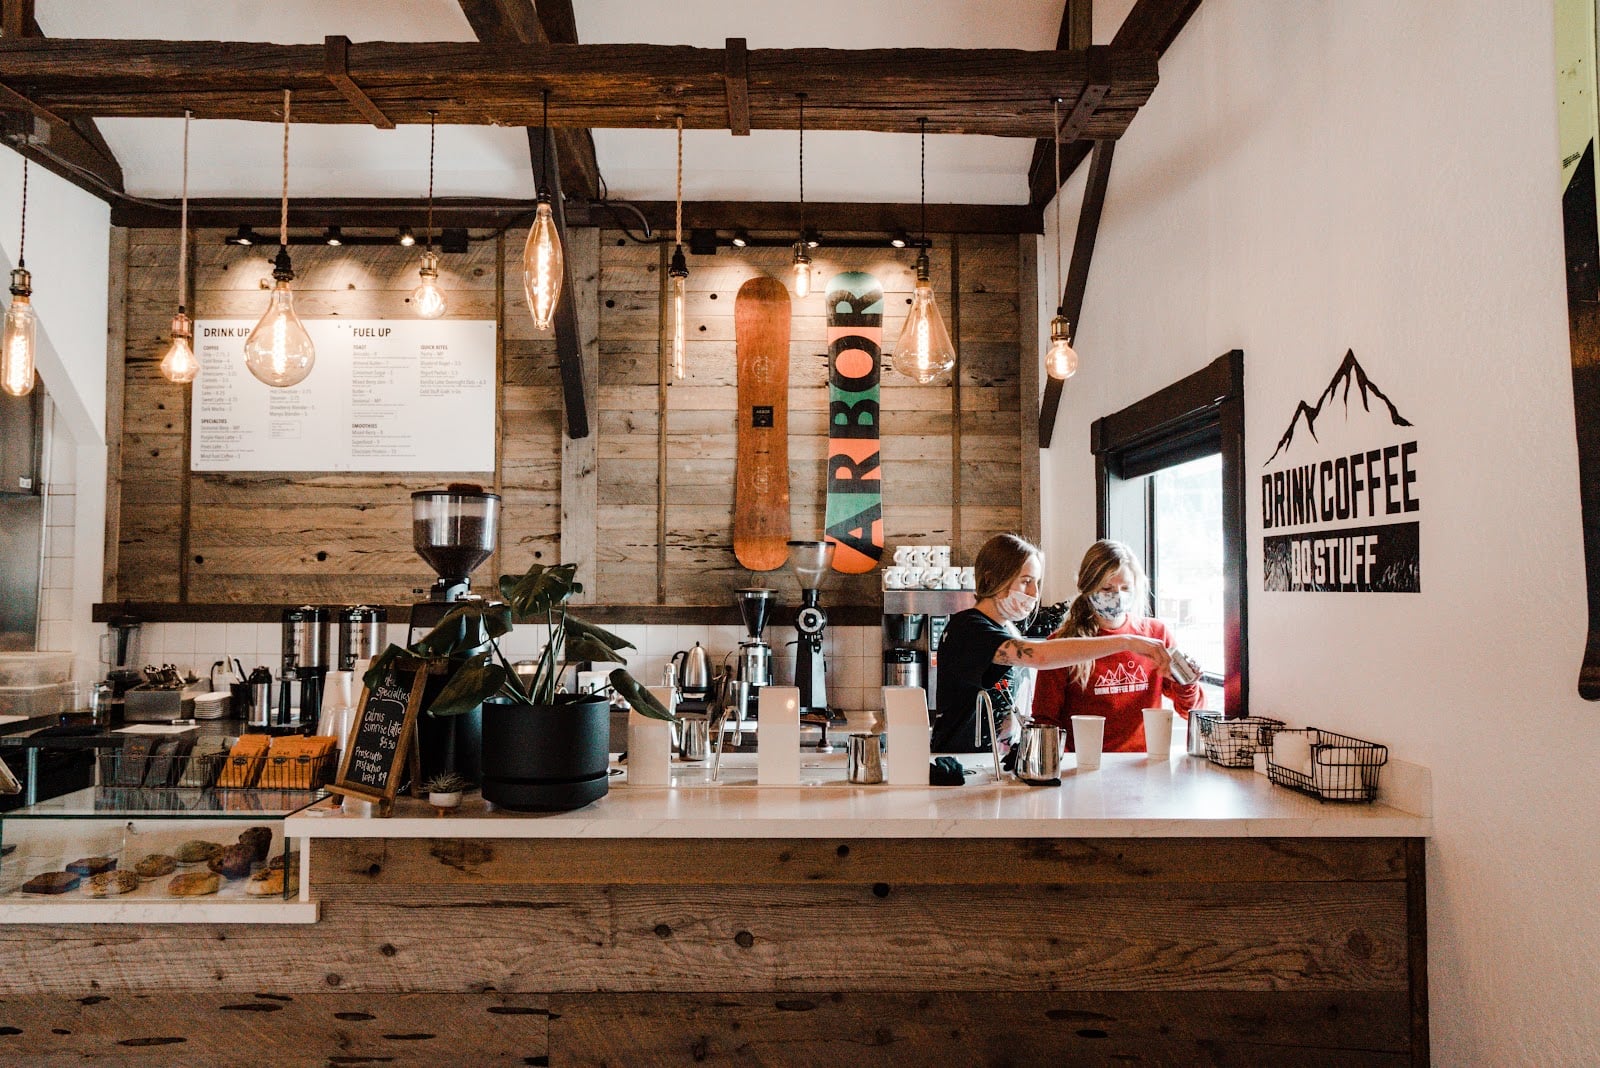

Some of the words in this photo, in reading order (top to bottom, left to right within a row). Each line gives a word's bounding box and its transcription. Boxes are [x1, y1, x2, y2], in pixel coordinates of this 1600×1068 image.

[204, 327, 234, 337] DRINK
[237, 327, 250, 337] UP
[353, 327, 376, 337] FUEL
[378, 327, 392, 337] UP
[826, 289, 883, 560] ARBOR
[1261, 463, 1318, 529] DRINK
[1319, 440, 1420, 523] COFFEE
[1291, 539, 1313, 585] DO
[1313, 534, 1379, 585] STUFF
[1110, 686, 1128, 694] COFFEE
